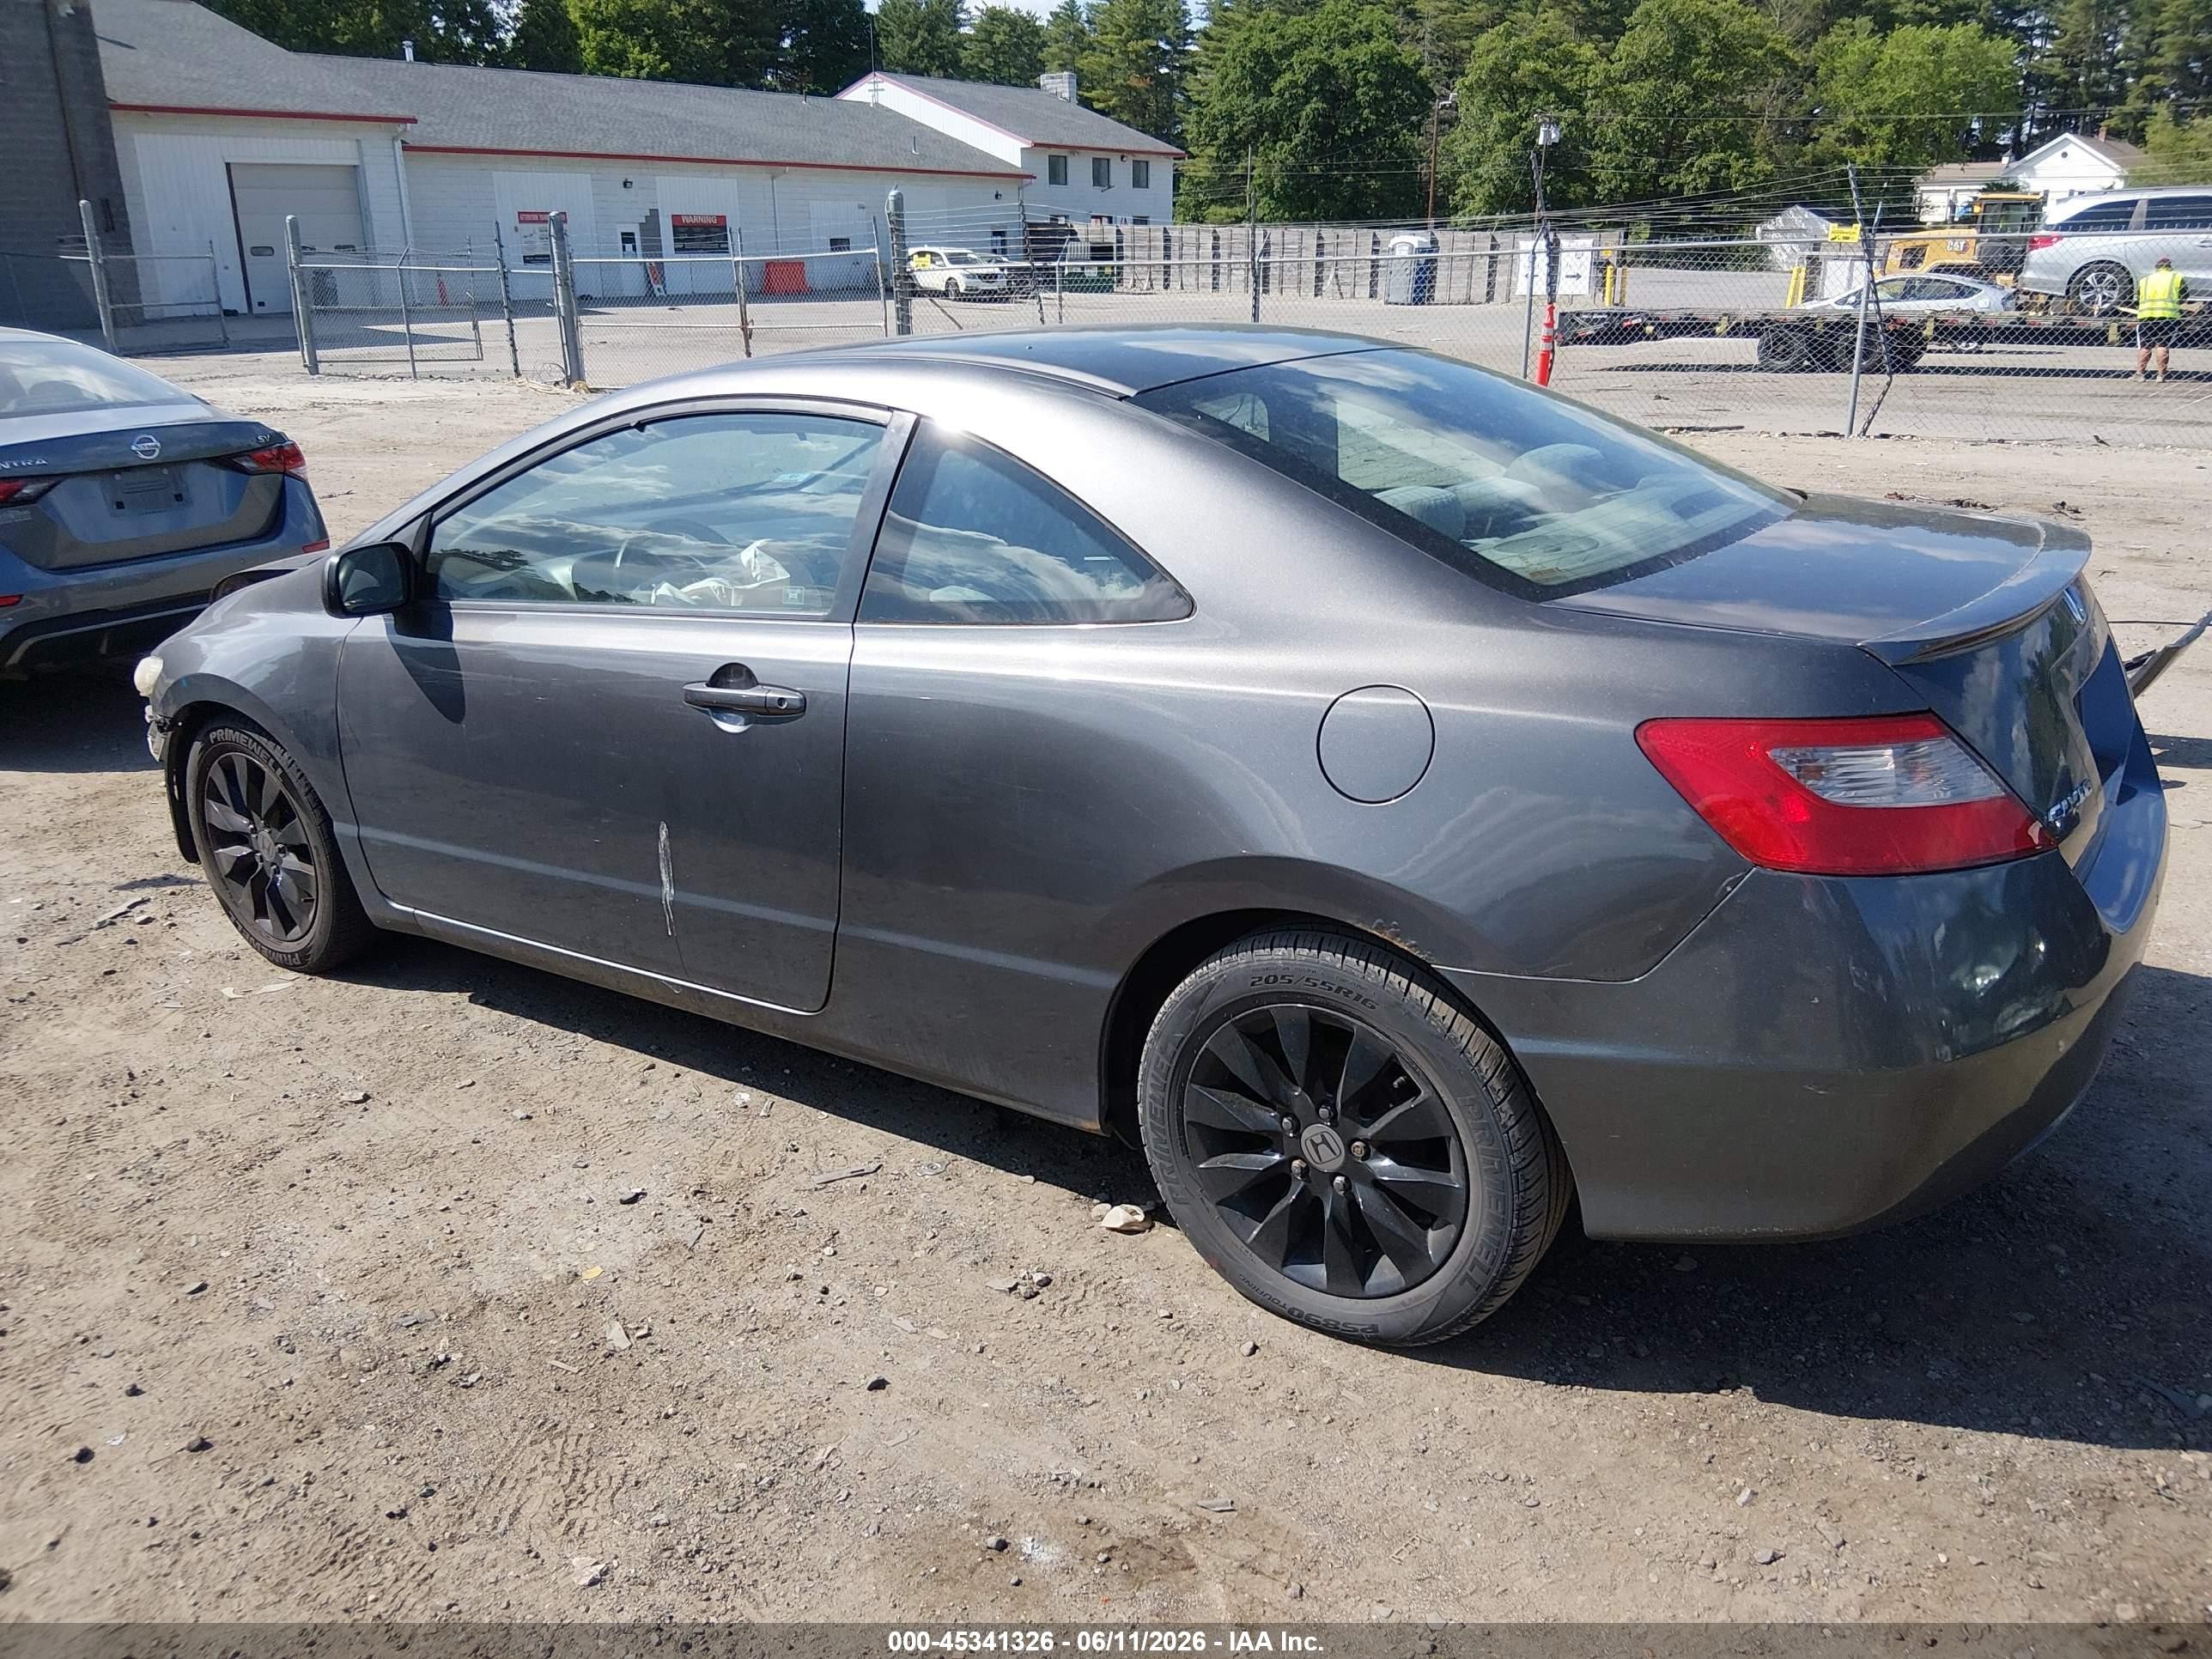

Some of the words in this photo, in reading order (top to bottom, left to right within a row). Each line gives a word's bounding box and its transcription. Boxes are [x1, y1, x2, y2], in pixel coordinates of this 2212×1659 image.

[681, 215, 718, 224] WARNING
[1947, 240, 1966, 252] CAT
[209, 727, 283, 782] PRIMEWELL
[1249, 974, 1380, 1011] 205/55R16
[1457, 1096, 1506, 1291] PRIMEWELL
[1237, 1273, 1288, 1312] TOURING
[1287, 1307, 1380, 1334] PS890
